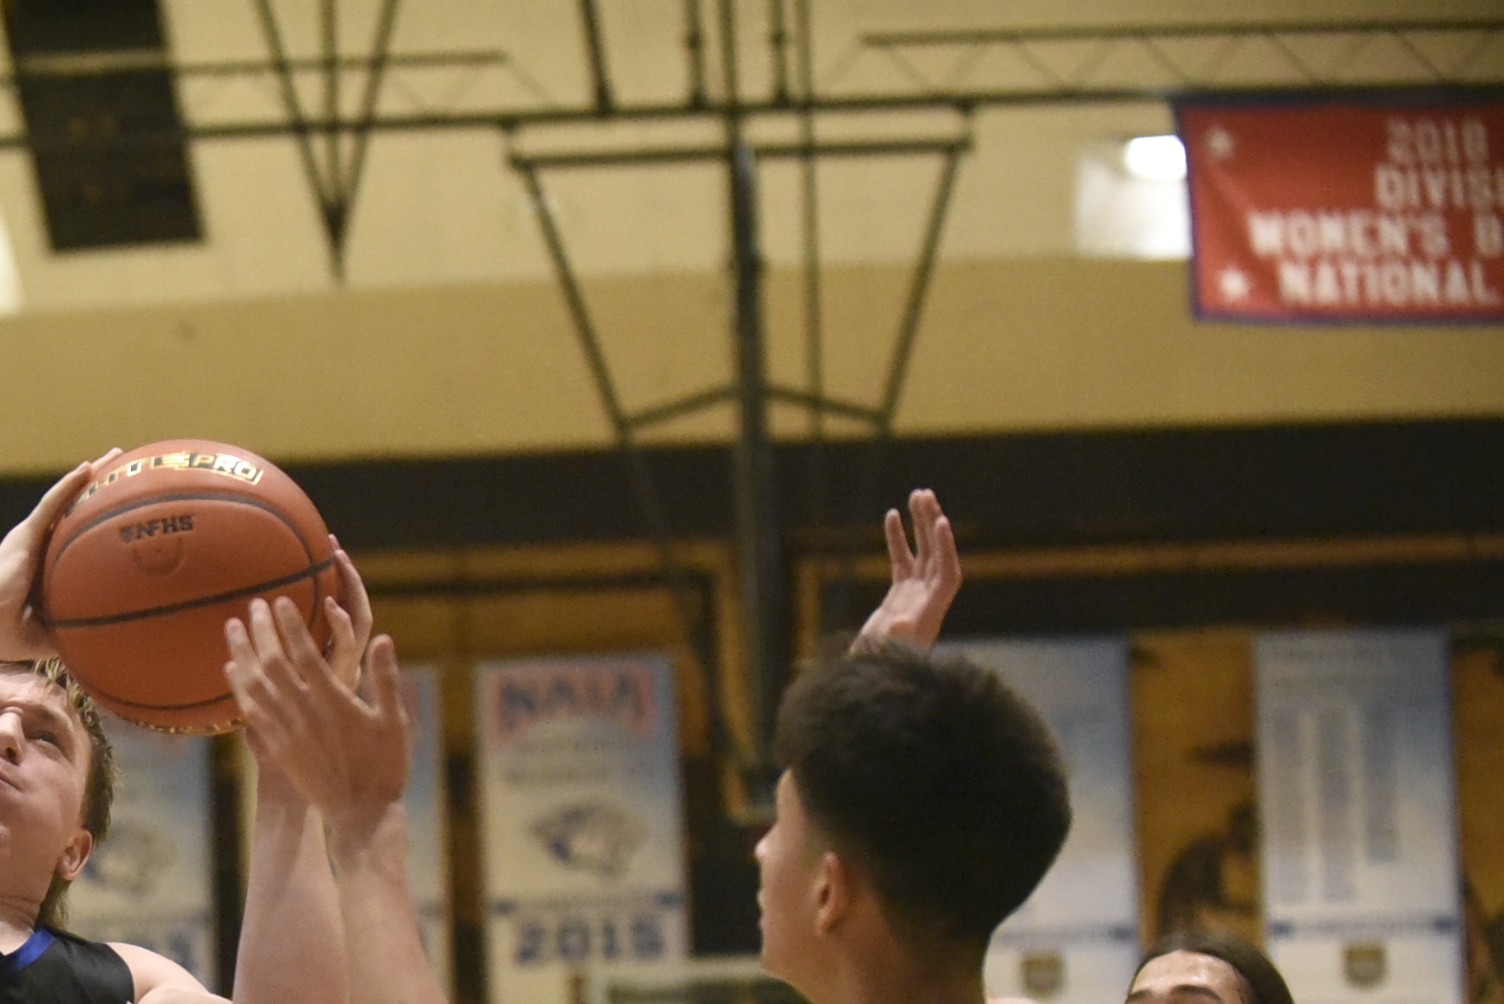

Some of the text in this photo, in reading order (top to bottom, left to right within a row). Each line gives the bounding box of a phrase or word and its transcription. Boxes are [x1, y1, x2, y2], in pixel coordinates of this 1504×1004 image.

[1246, 209, 1449, 259] WOMEN'S
[1277, 262, 1496, 308] NATIONAL
[195, 452, 262, 485] PRO
[134, 514, 194, 540] NFHS
